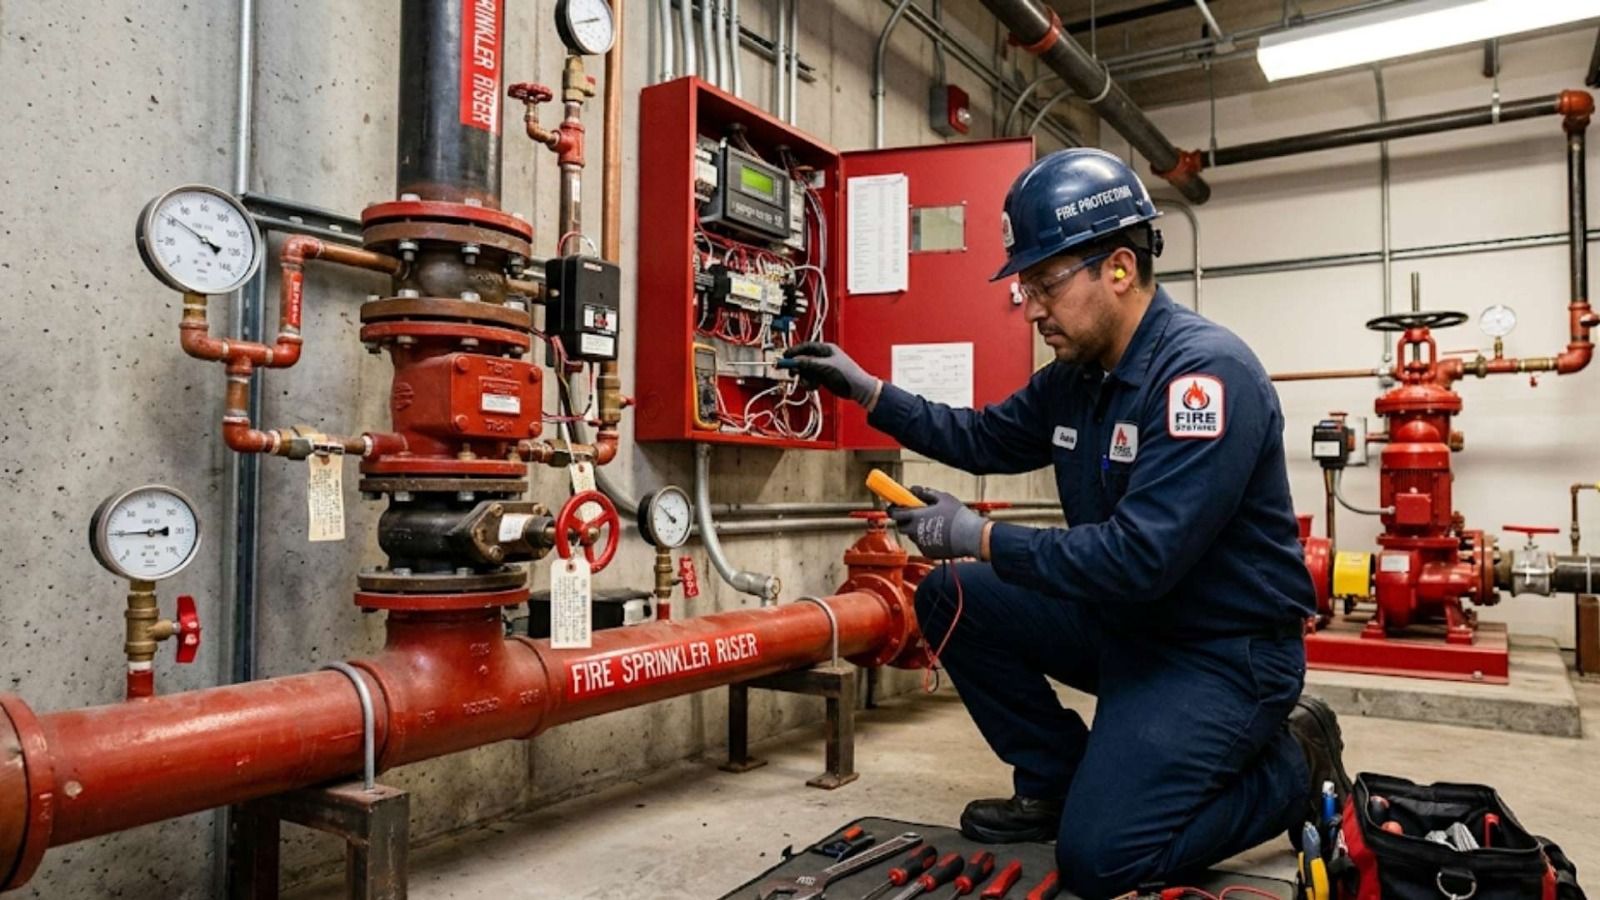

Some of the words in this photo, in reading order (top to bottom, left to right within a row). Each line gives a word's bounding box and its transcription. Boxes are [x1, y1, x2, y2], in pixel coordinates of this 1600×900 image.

[473, 0, 496, 69] RINKLER
[472, 73, 495, 125] RISER
[1055, 202, 1079, 222] FIRE
[1175, 412, 1217, 424] FIRE
[571, 658, 615, 694] FIRE
[622, 641, 711, 684] SPRINKLER
[715, 633, 759, 664] RISER
